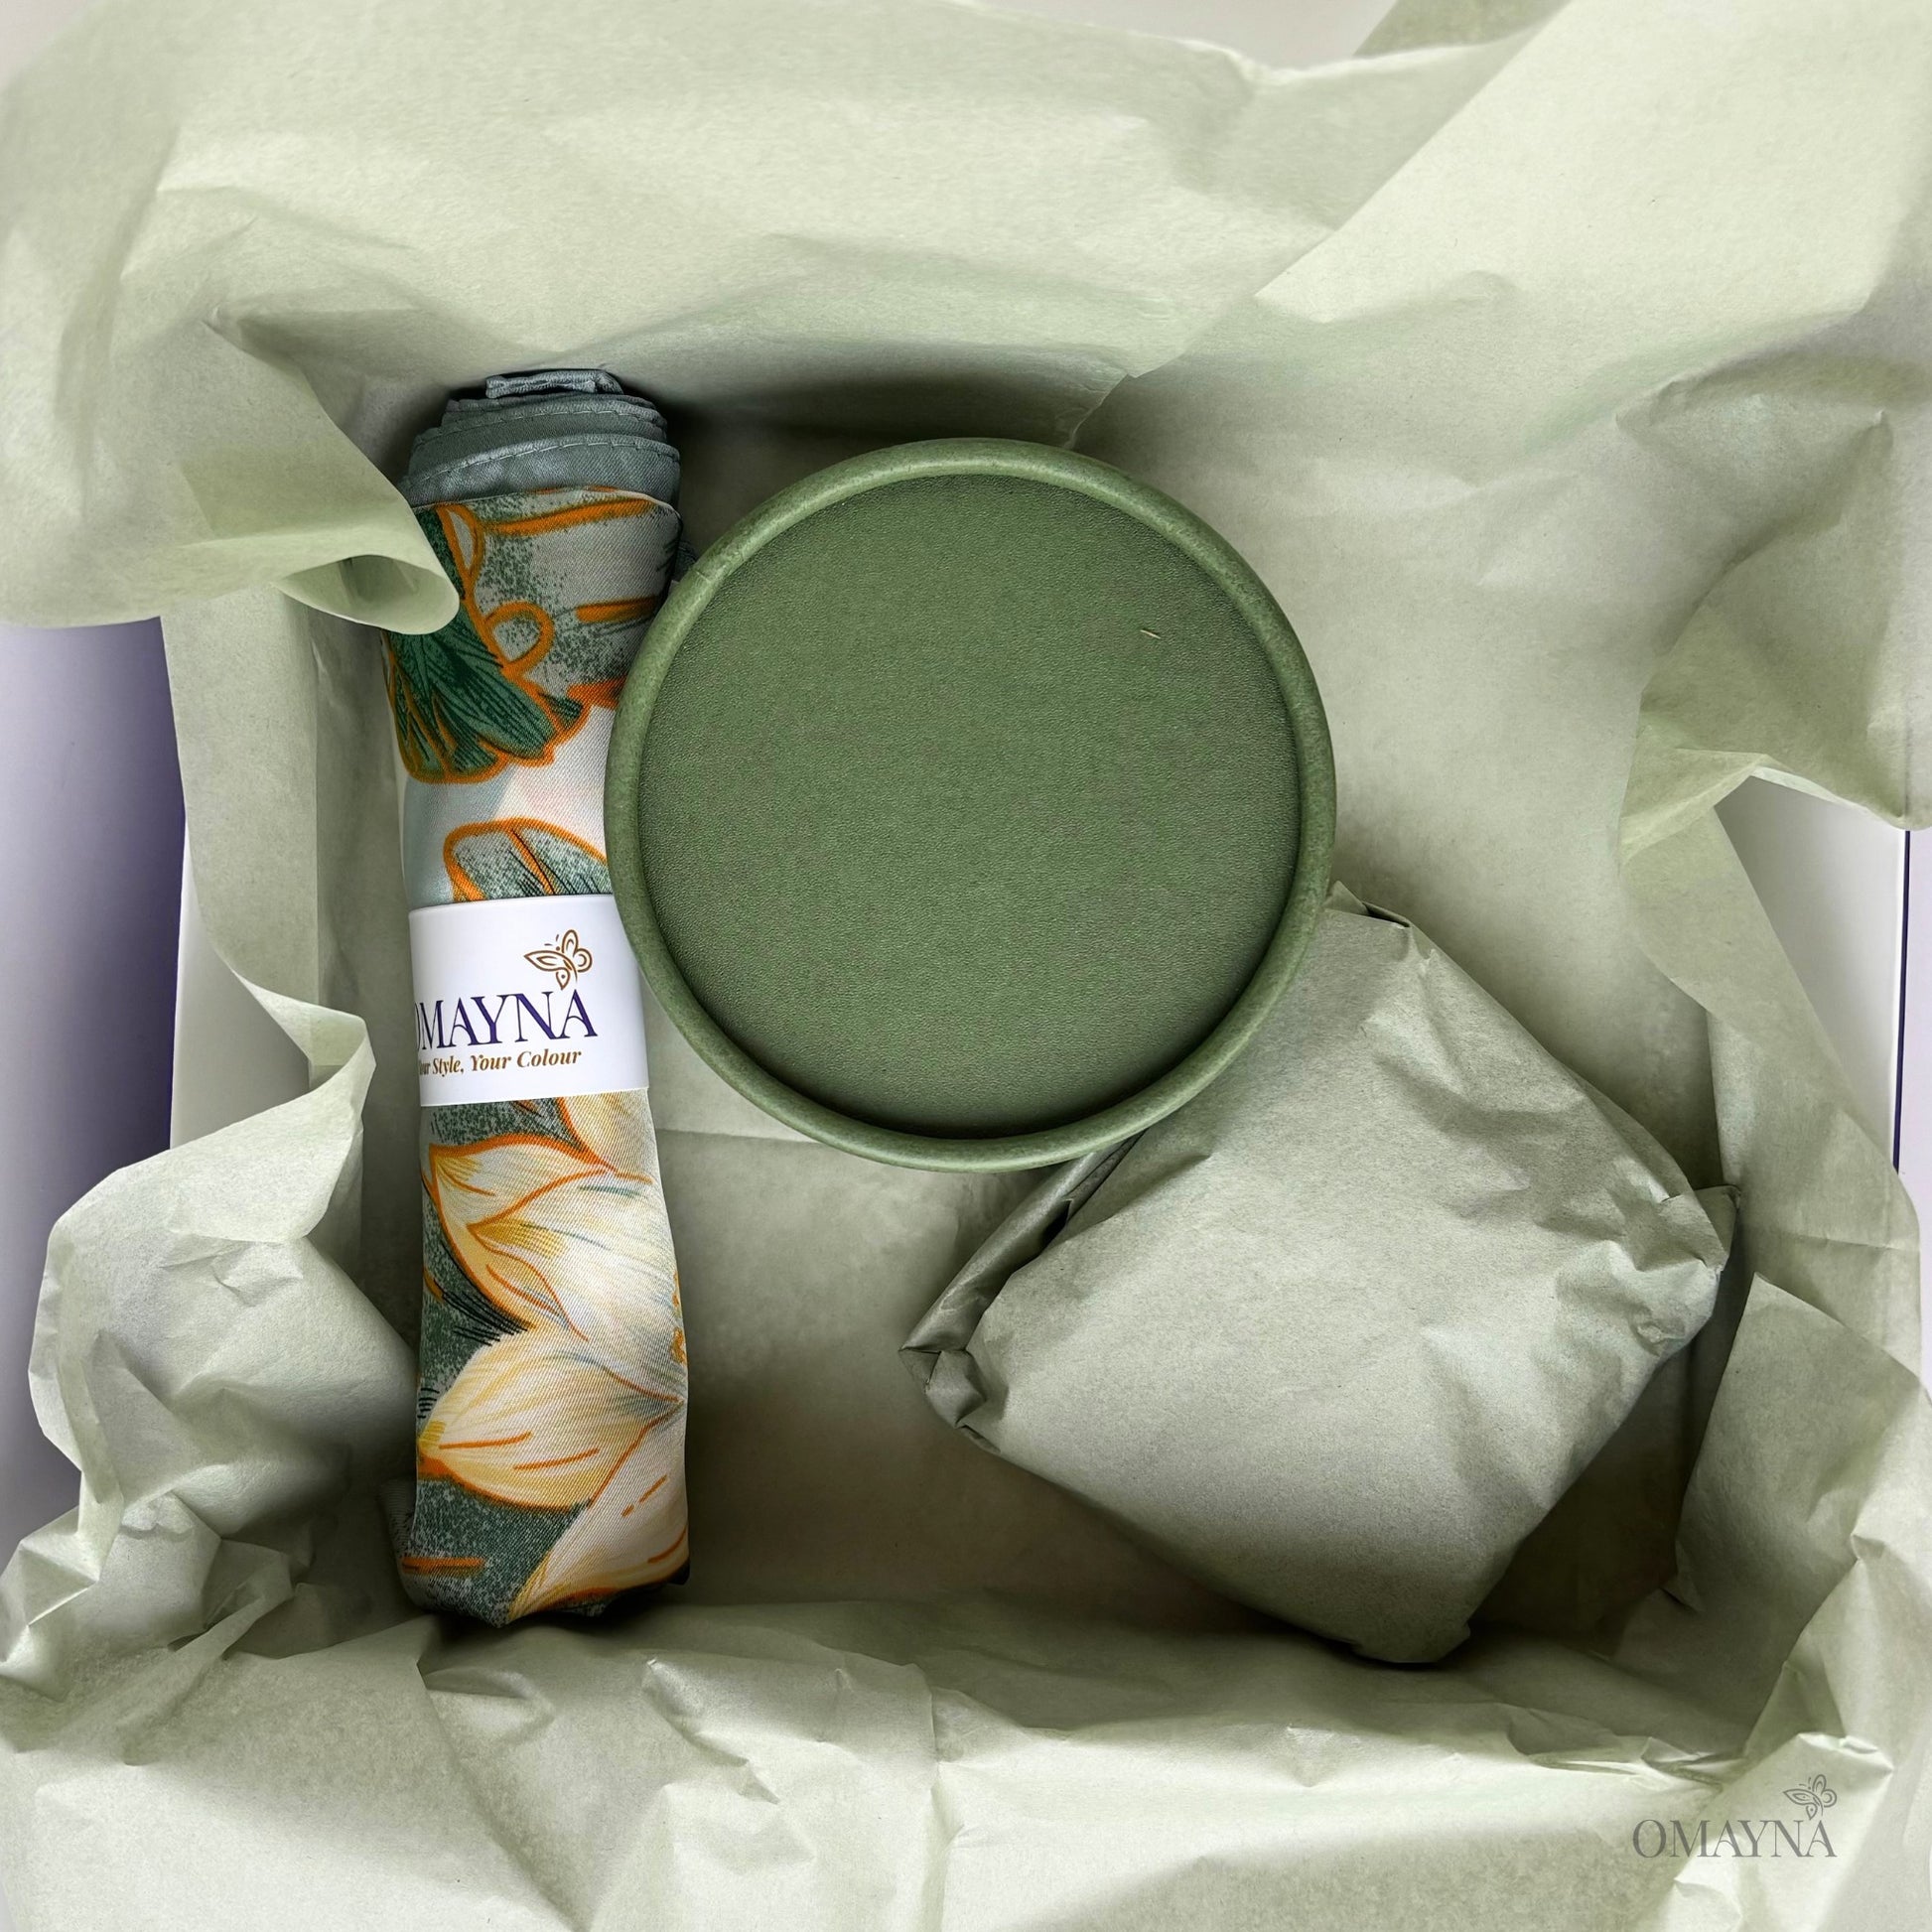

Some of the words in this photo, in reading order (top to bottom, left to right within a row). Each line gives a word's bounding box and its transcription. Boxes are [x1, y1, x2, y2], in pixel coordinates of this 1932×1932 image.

[415, 989, 598, 1050] MAYNA
[433, 1055, 465, 1077] Style,
[471, 1054, 511, 1071] Your
[516, 1049, 582, 1068] Colour
